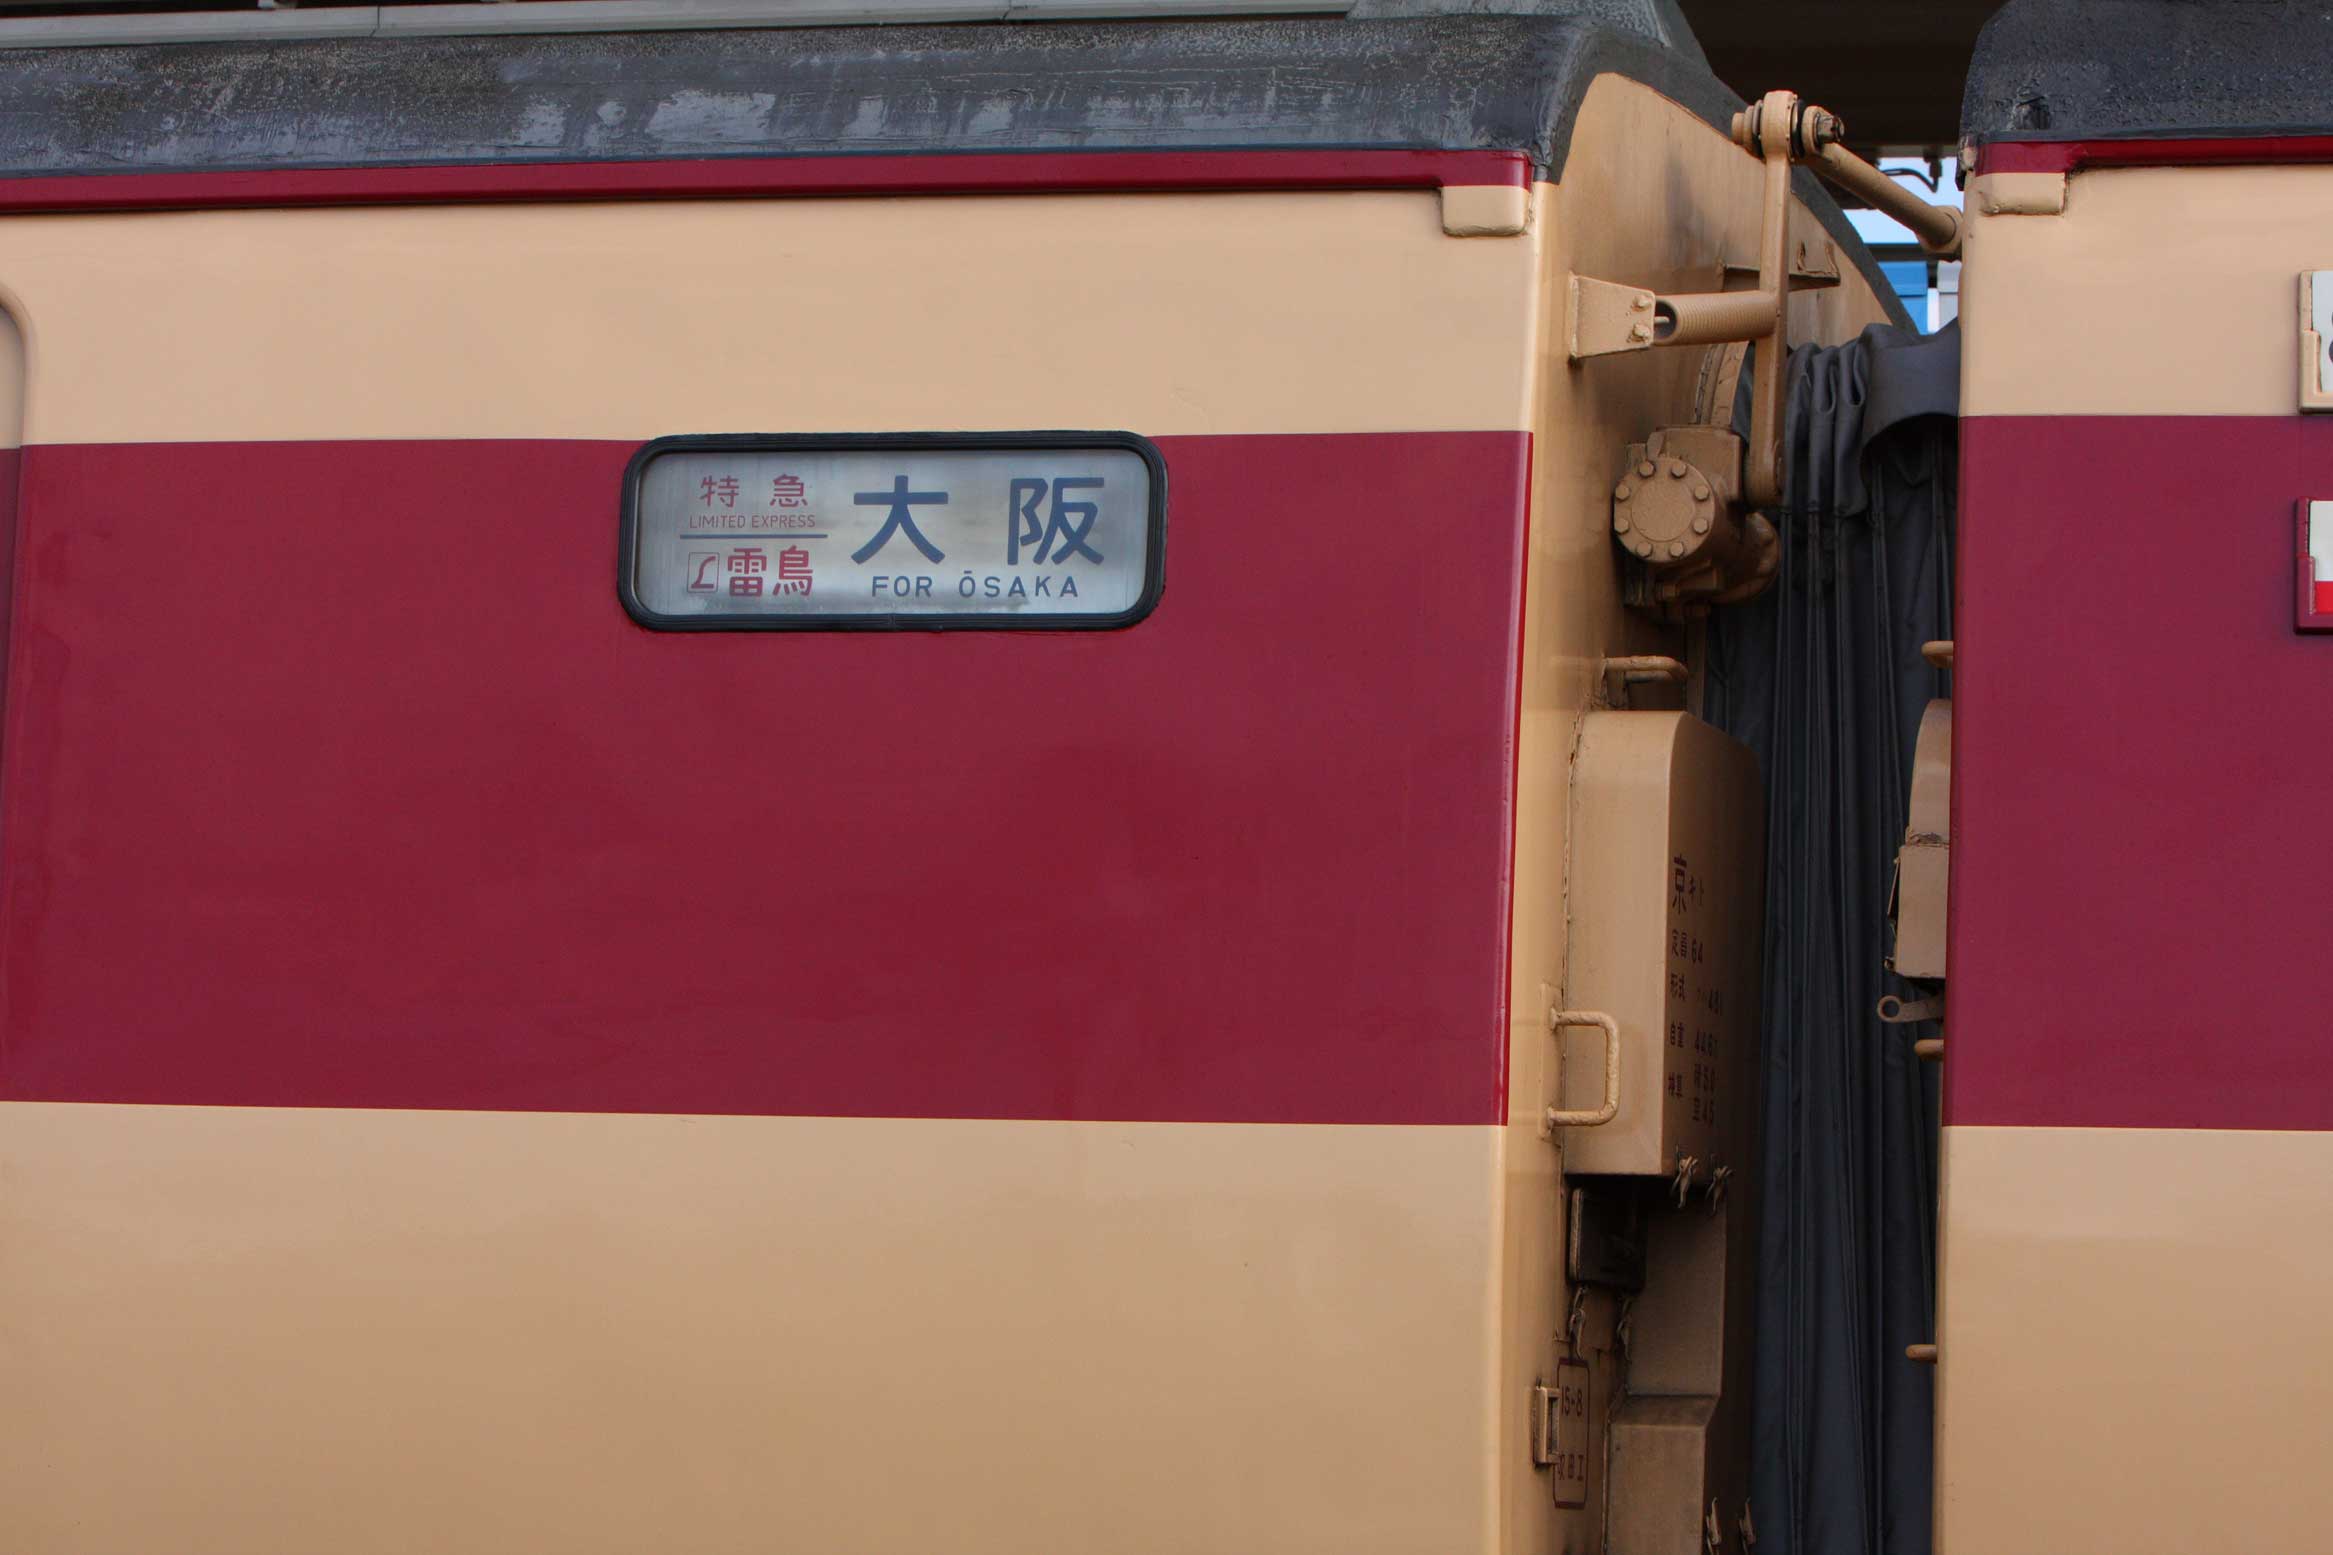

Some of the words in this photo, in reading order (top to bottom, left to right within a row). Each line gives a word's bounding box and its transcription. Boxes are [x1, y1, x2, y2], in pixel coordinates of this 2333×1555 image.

[700, 473, 808, 508] 特急
[689, 514, 746, 529] LIMITED
[751, 513, 816, 529] EXPRESS
[850, 475, 1105, 566] 大阪
[727, 545, 814, 597] 雷鳥
[871, 576, 932, 598] FOR
